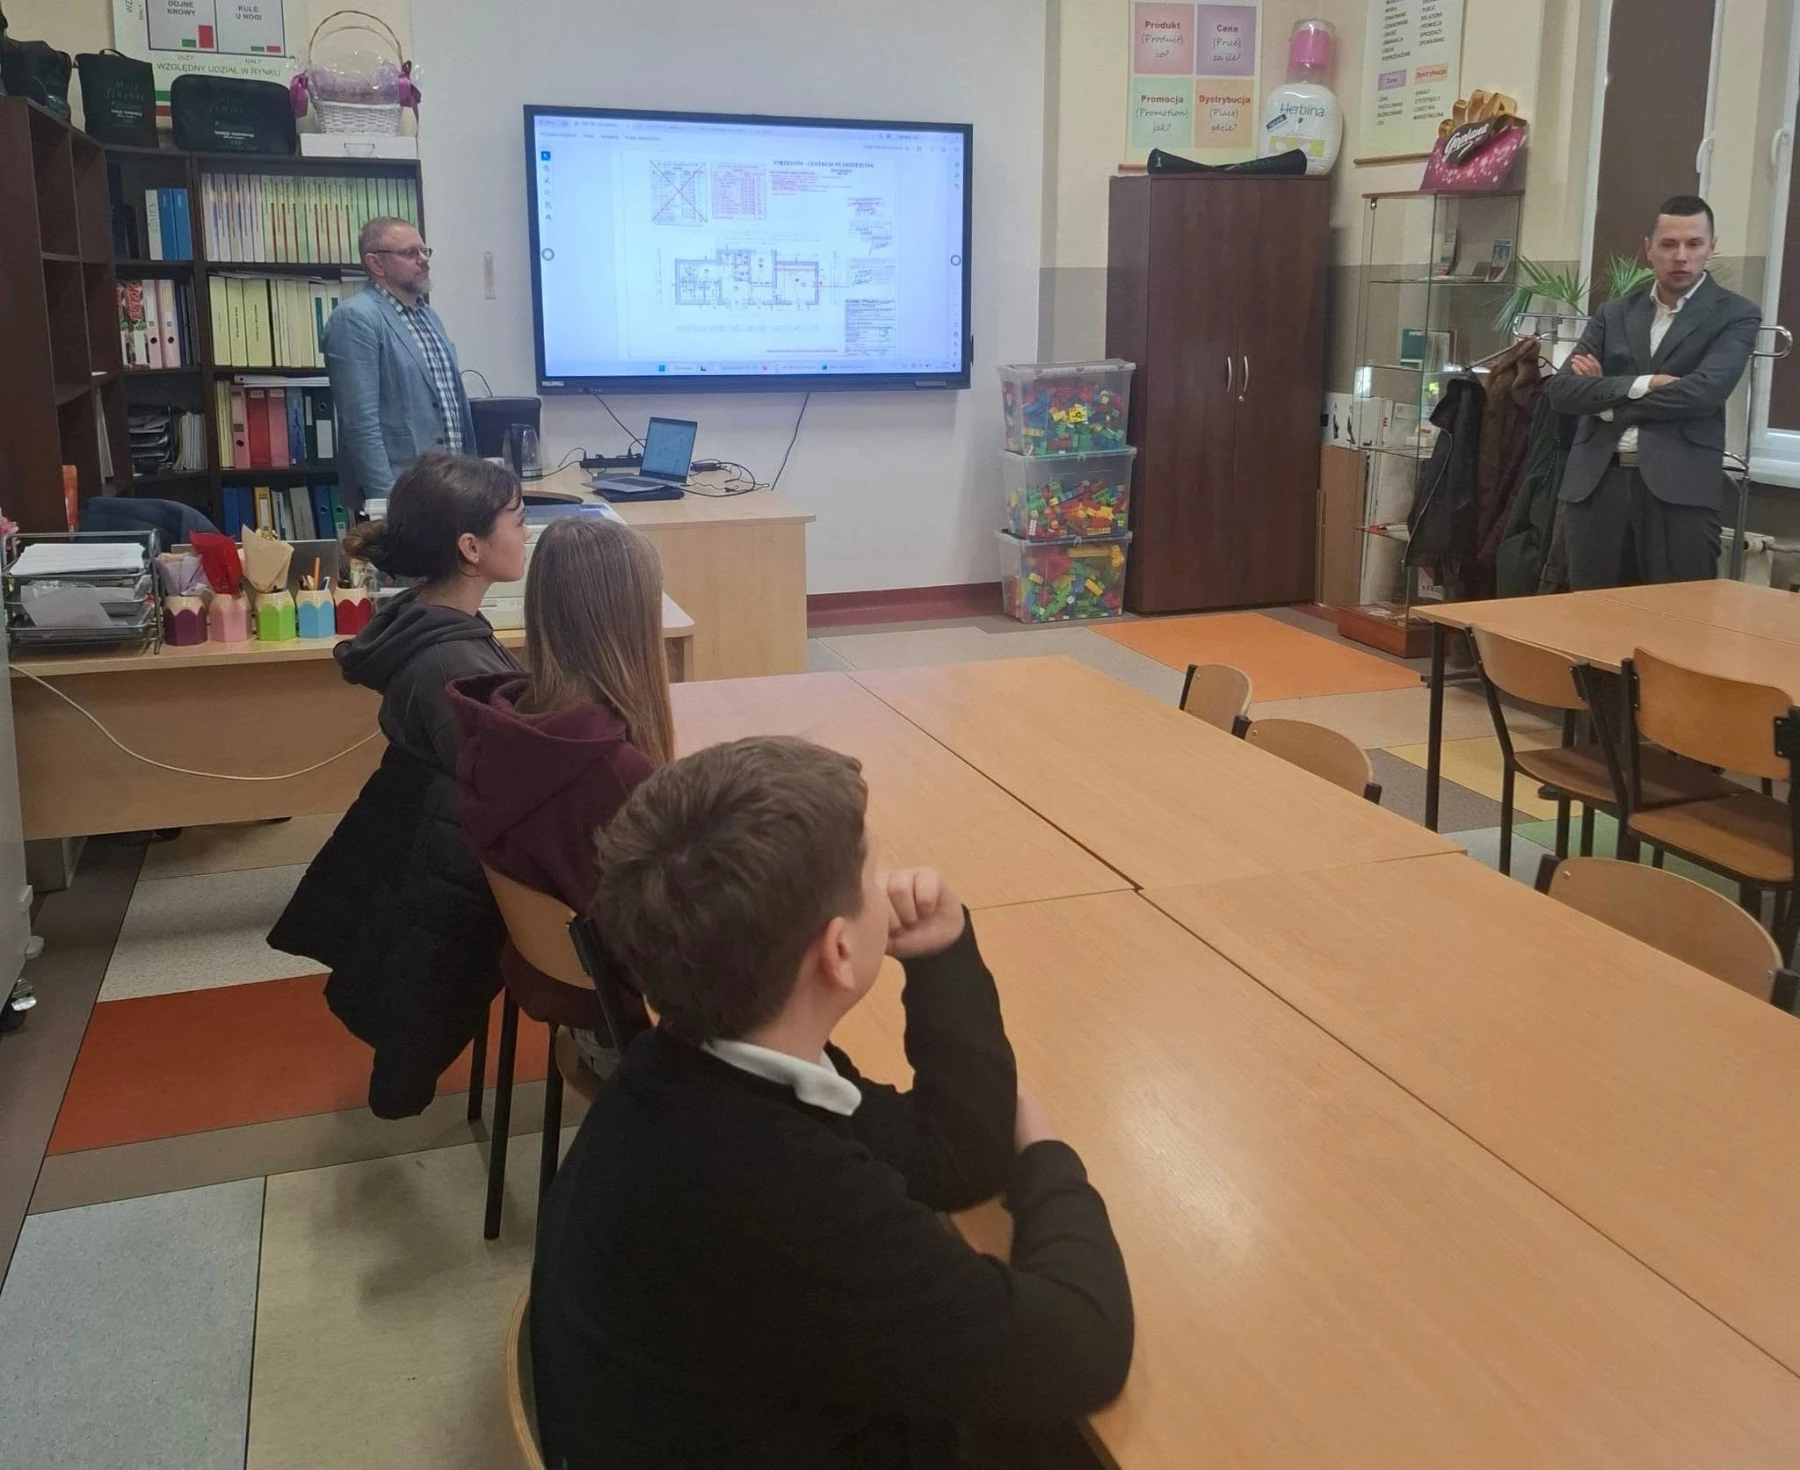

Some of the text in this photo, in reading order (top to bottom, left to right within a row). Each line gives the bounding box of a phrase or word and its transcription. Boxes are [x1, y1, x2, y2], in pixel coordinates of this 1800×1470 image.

[168, 0, 194, 8] DOJNE
[1145, 20, 1181, 30] Produkt
[157, 62, 205, 73] WZGLĘDNY
[251, 68, 280, 77] RYNKU
[1141, 95, 1184, 104] Promocja
[1199, 95, 1251, 105] Dystrybucja
[1280, 102, 1325, 117] Herbina
